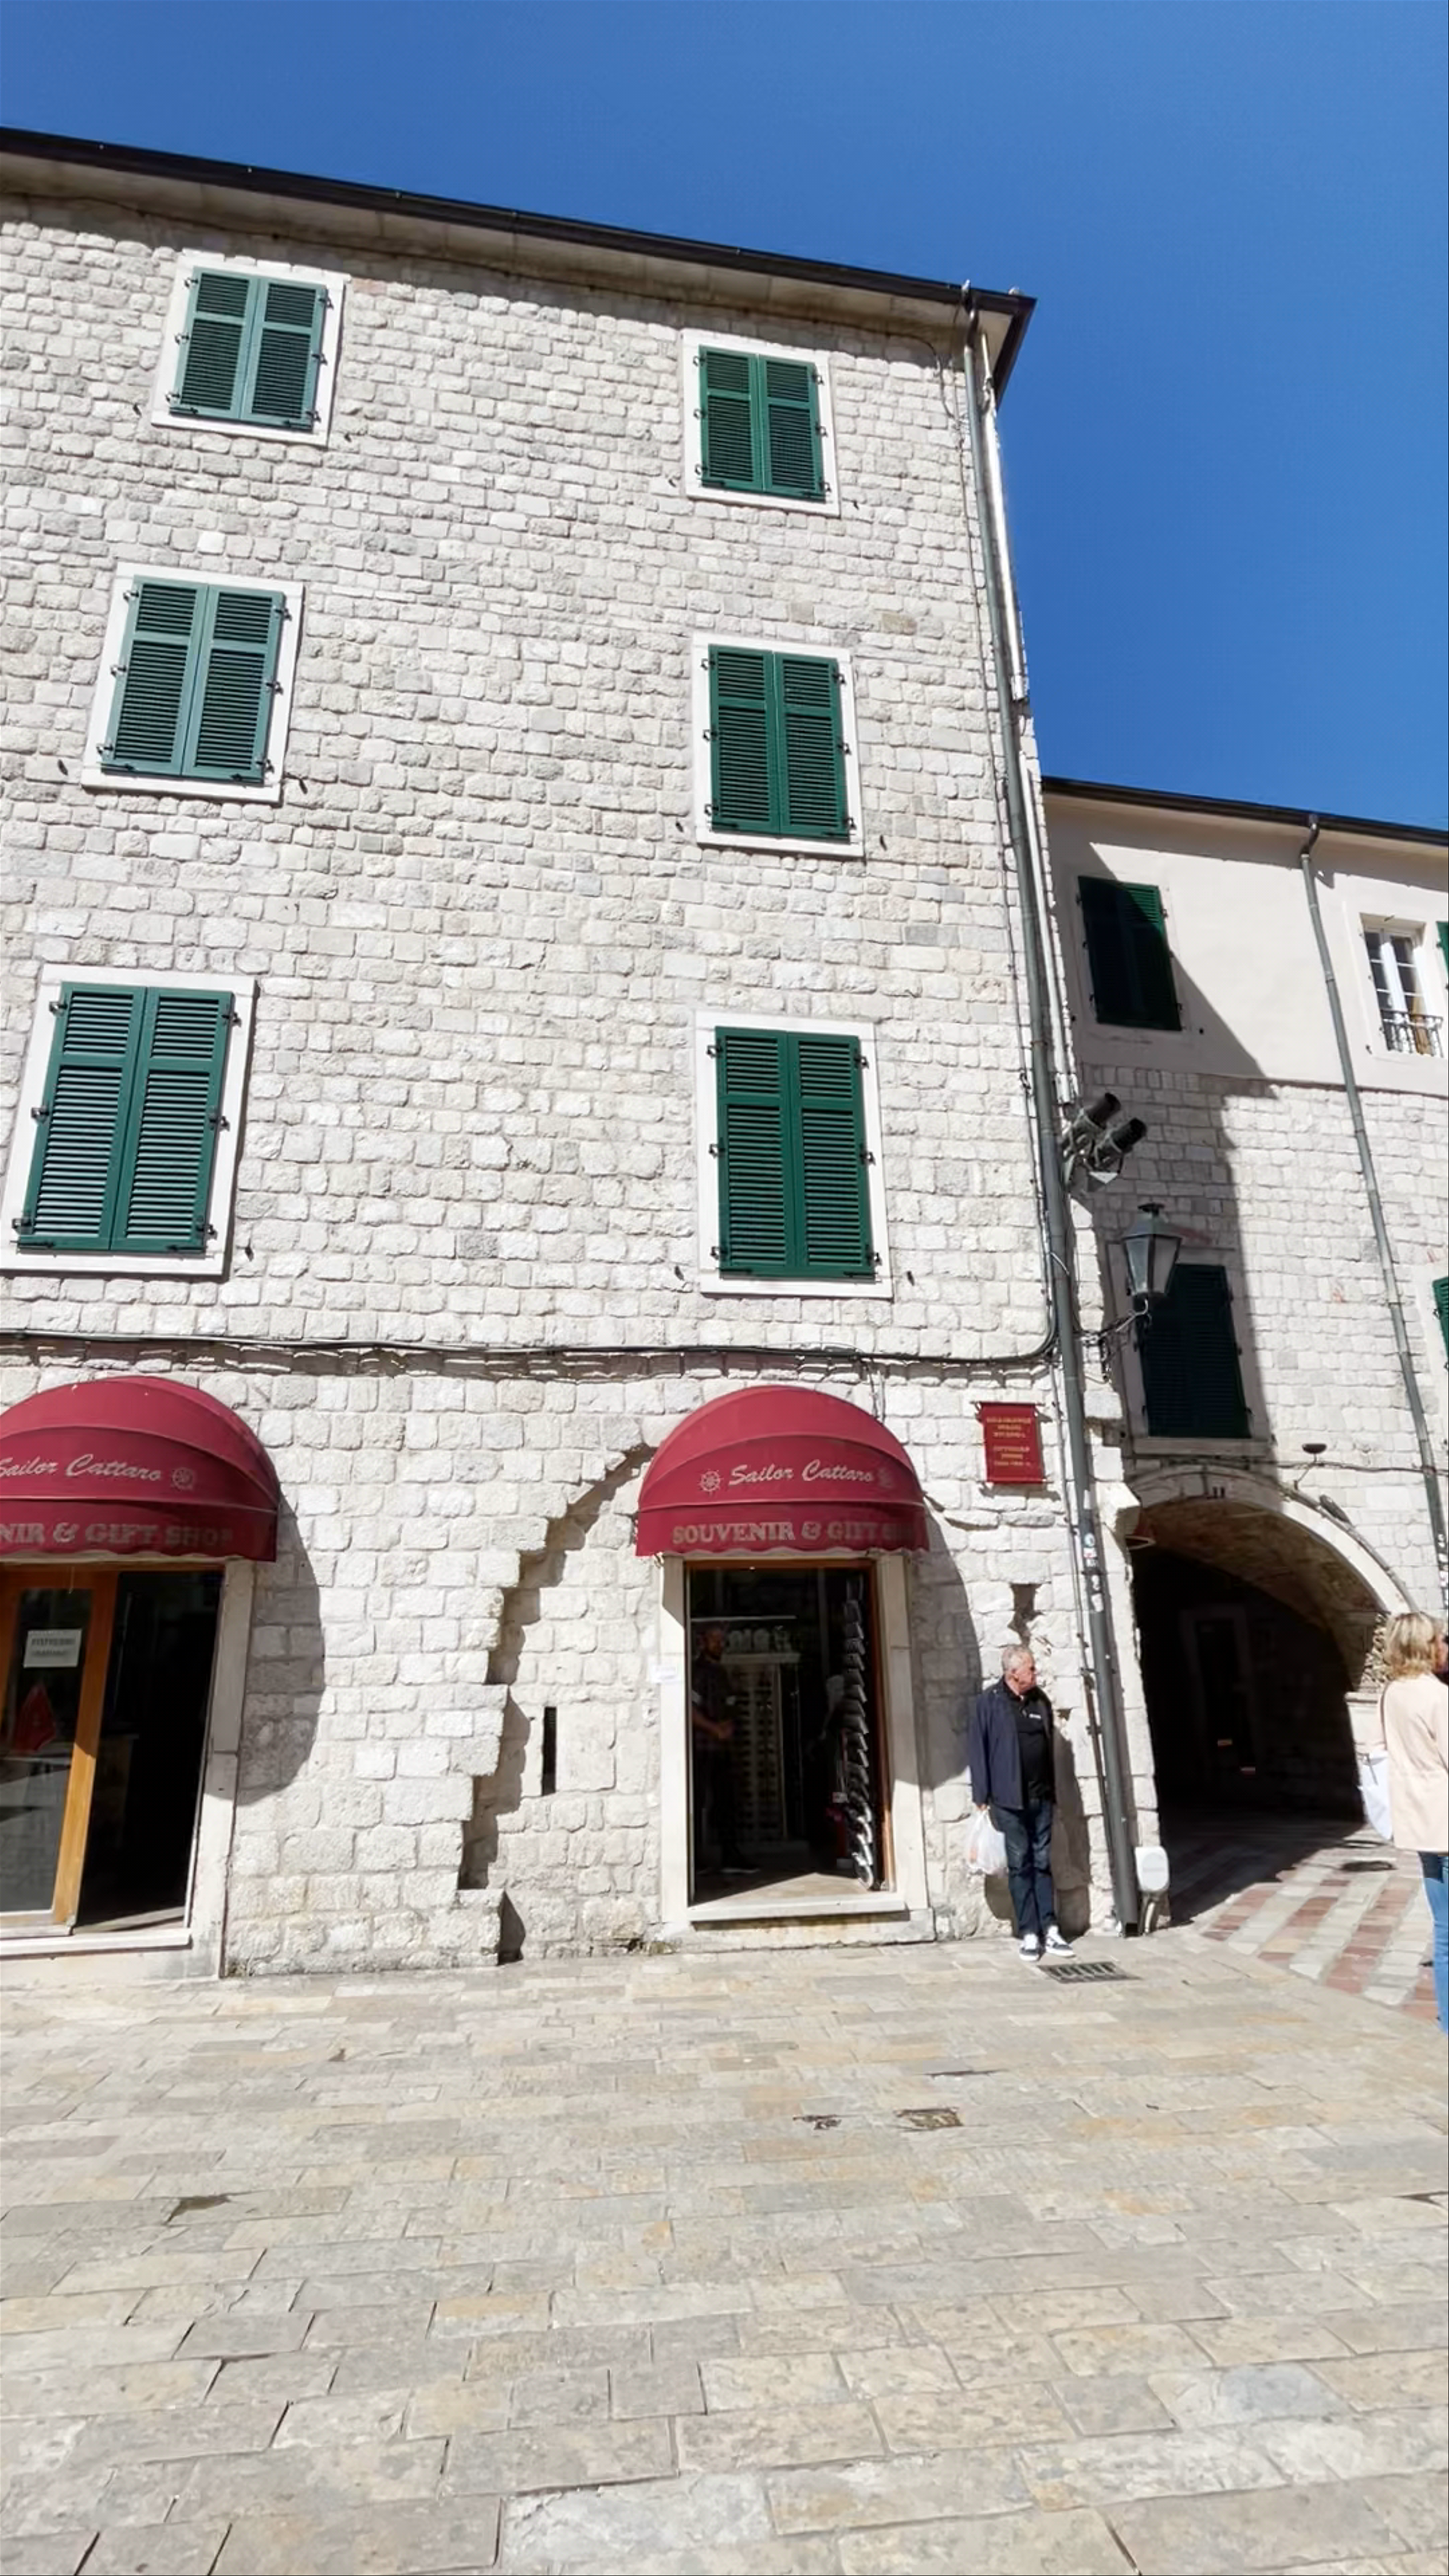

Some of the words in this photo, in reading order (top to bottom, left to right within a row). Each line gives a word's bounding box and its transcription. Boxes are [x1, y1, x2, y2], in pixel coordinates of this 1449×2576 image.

[0, 1456, 58, 1478] Sailor
[66, 1453, 161, 1481] Cattaro
[729, 1464, 793, 1486] Sailor
[801, 1459, 874, 1482] Cattaro
[53, 1522, 80, 1544] &
[85, 1523, 158, 1544] GIFT
[672, 1521, 795, 1544] SOUVENIR
[801, 1521, 821, 1540] &
[828, 1521, 878, 1540] GIFT
